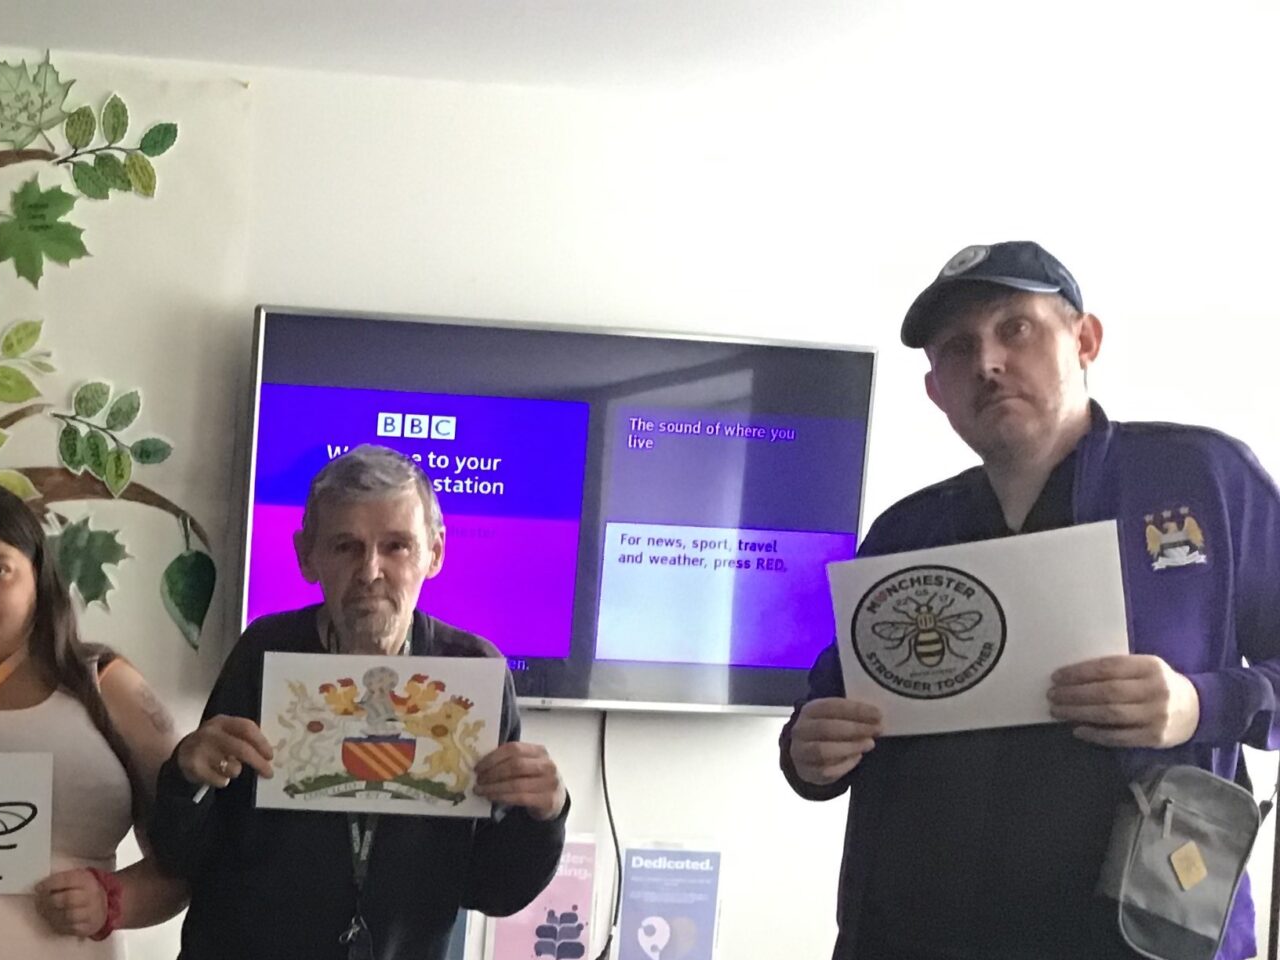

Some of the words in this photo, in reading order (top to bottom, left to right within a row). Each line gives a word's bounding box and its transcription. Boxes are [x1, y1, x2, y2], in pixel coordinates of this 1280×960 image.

[382, 415, 453, 437] BBC
[629, 417, 654, 431] The
[658, 420, 702, 434] sound
[706, 422, 721, 435] of
[724, 423, 766, 438] where
[770, 428, 796, 442] you
[627, 435, 654, 449] live
[428, 451, 450, 469] to
[454, 455, 502, 474] your
[432, 476, 505, 495] station
[620, 533, 642, 546] For
[647, 536, 686, 550] news,
[691, 538, 732, 552] sport,
[738, 538, 778, 553] travel
[618, 551, 644, 564] and
[649, 553, 708, 569] weather,
[713, 557, 751, 571] press
[866, 652, 931, 691] STRONGER
[936, 642, 995, 690] TOGETHER
[631, 855, 714, 871] Dedicated.
